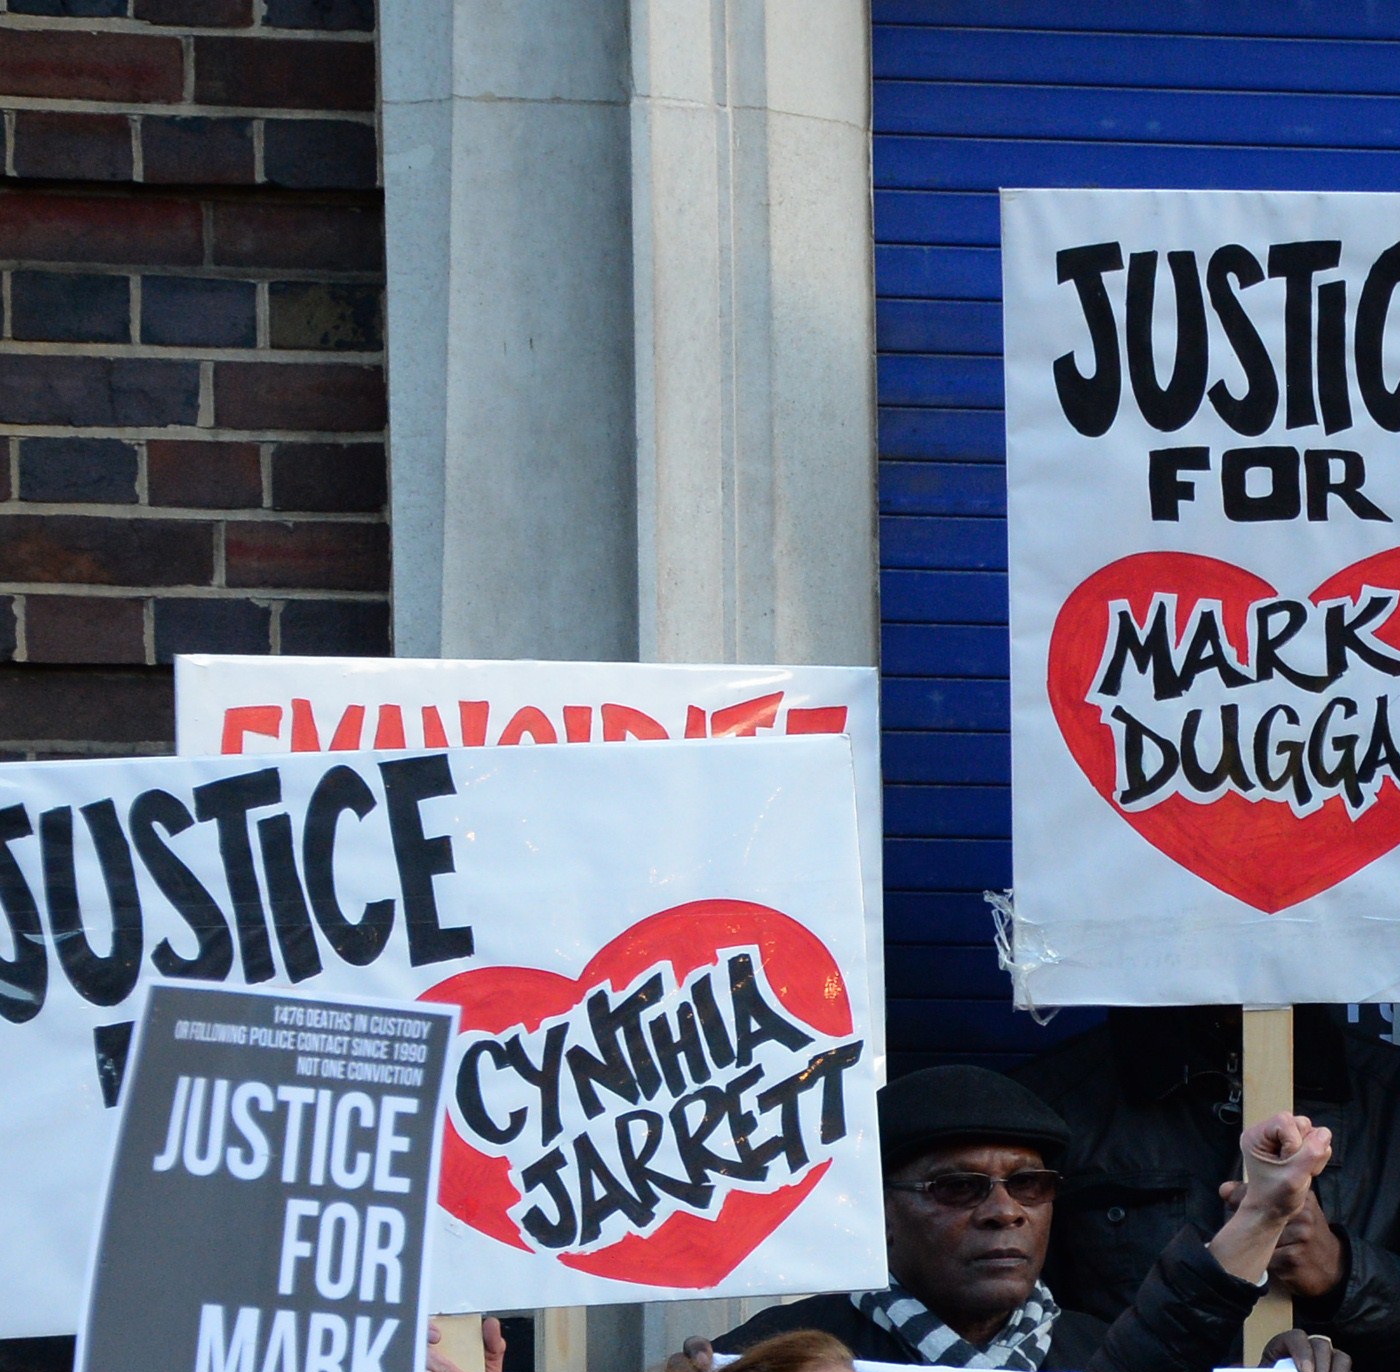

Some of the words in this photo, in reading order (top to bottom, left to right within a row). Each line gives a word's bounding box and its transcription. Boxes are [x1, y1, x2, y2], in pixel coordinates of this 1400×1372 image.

[1149, 447, 1394, 523] FOR
[175, 1020, 190, 1039] OR
[191, 1021, 247, 1045] FOLLOWING
[250, 1027, 296, 1050] POLICE
[297, 1031, 350, 1055] CONTACT
[351, 1038, 389, 1060] SINCE
[393, 1043, 428, 1064] 1990
[274, 1005, 303, 1025] 1476
[306, 1007, 351, 1032] DEATHS
[354, 1014, 367, 1033] IN
[370, 1016, 432, 1039] CUSTODY
[457, 954, 814, 1147] CYNTHIA
[296, 1056, 319, 1077] NOT
[321, 1059, 346, 1079] ONE
[347, 1061, 423, 1087] CONVICTION
[153, 1075, 419, 1193] JUSTICE
[520, 1042, 864, 1248] JARRETT
[278, 1199, 406, 1304] FOR
